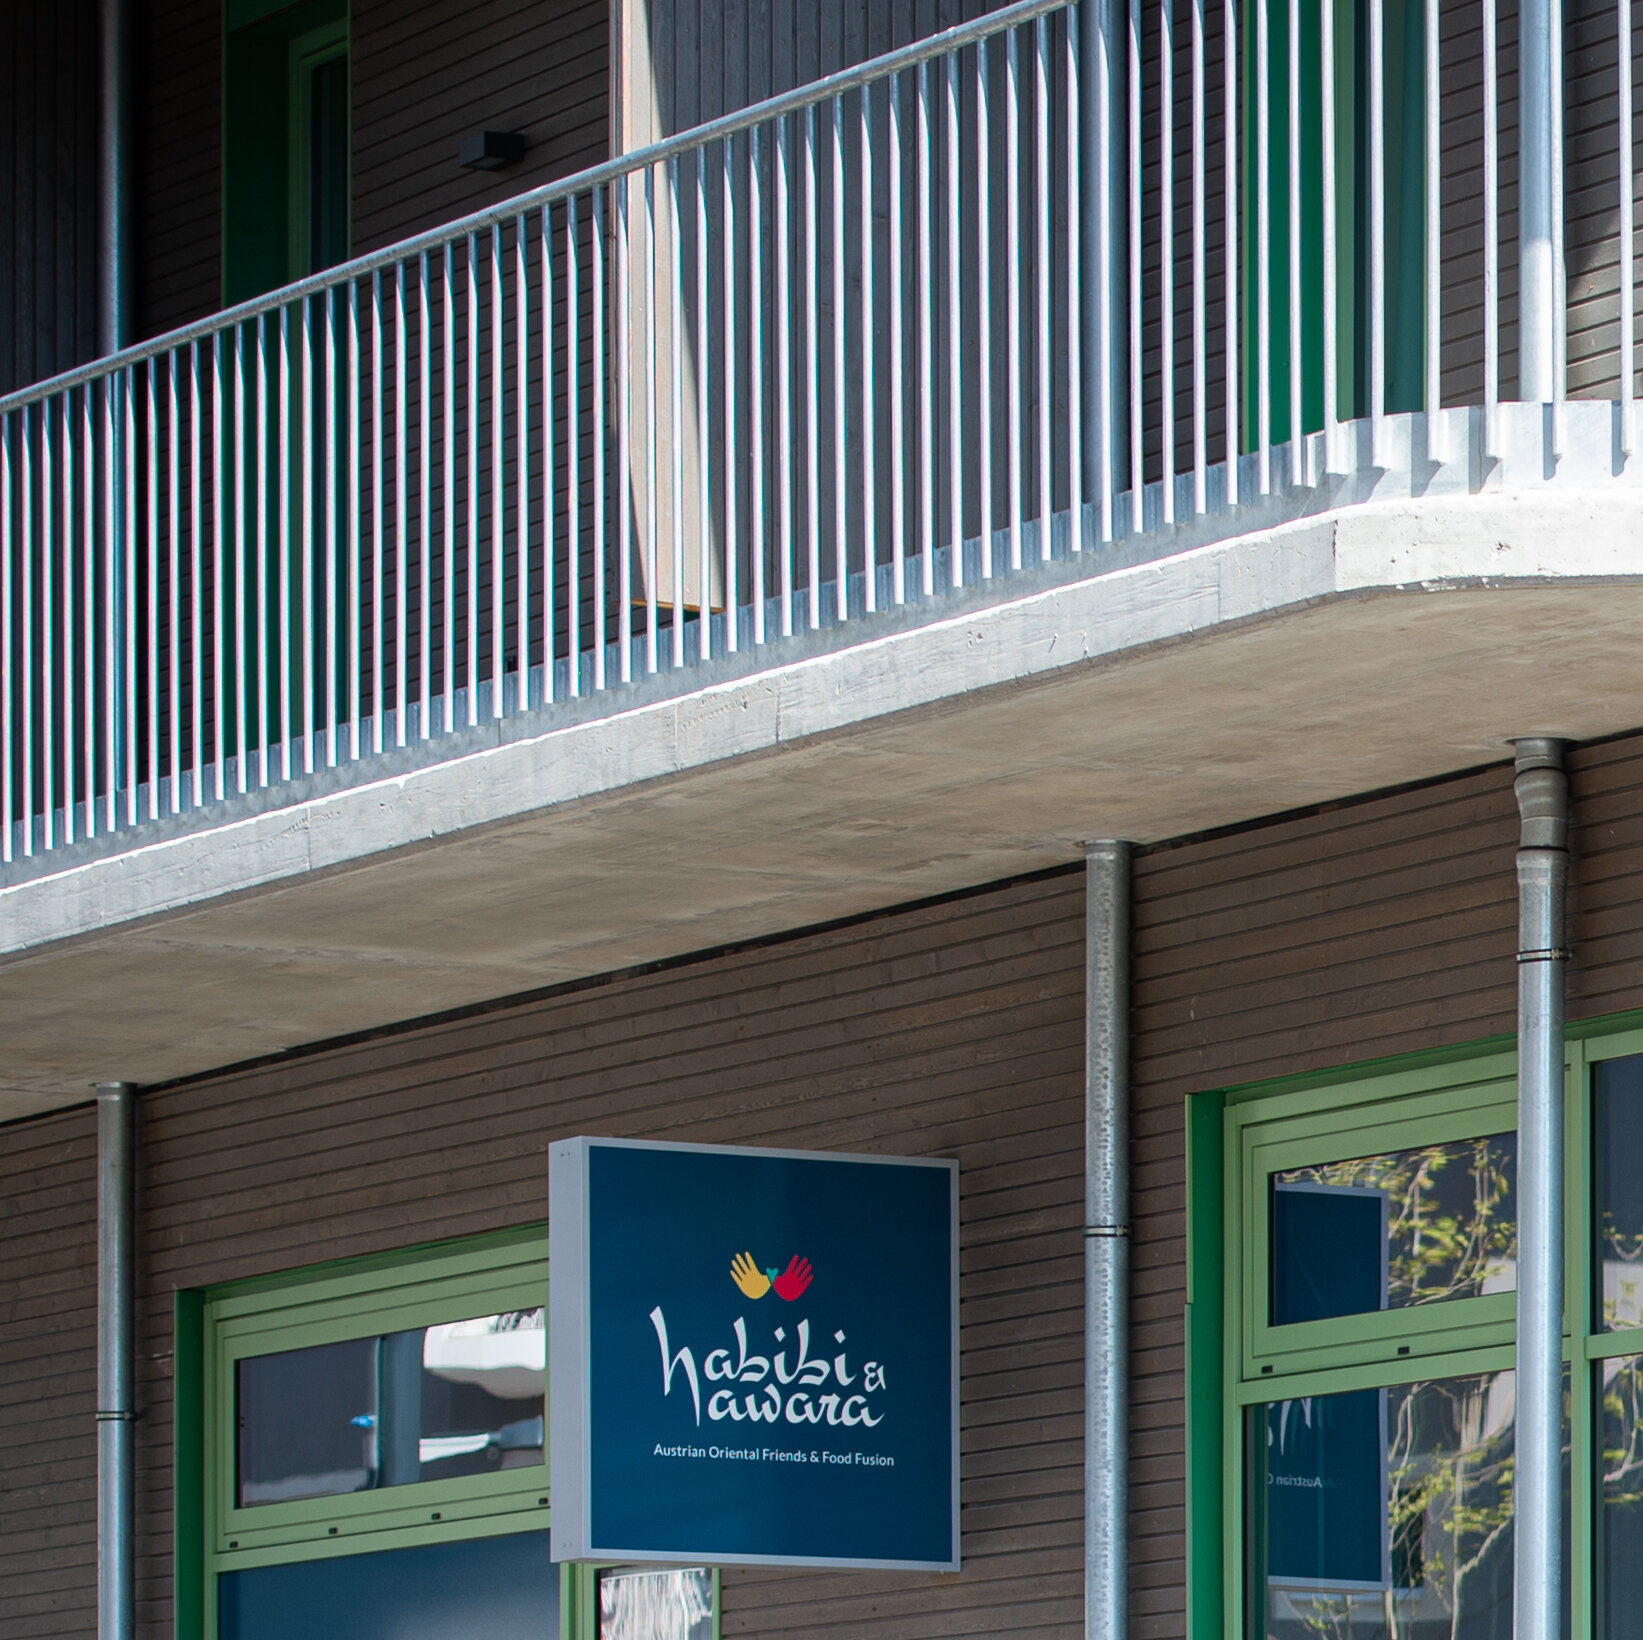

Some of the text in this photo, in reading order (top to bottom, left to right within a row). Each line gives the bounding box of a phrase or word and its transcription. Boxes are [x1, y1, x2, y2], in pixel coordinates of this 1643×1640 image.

[649, 1306, 857, 1427] habibi
[653, 1443, 895, 1467] Austrian Oriental Friends & Food Fusion
